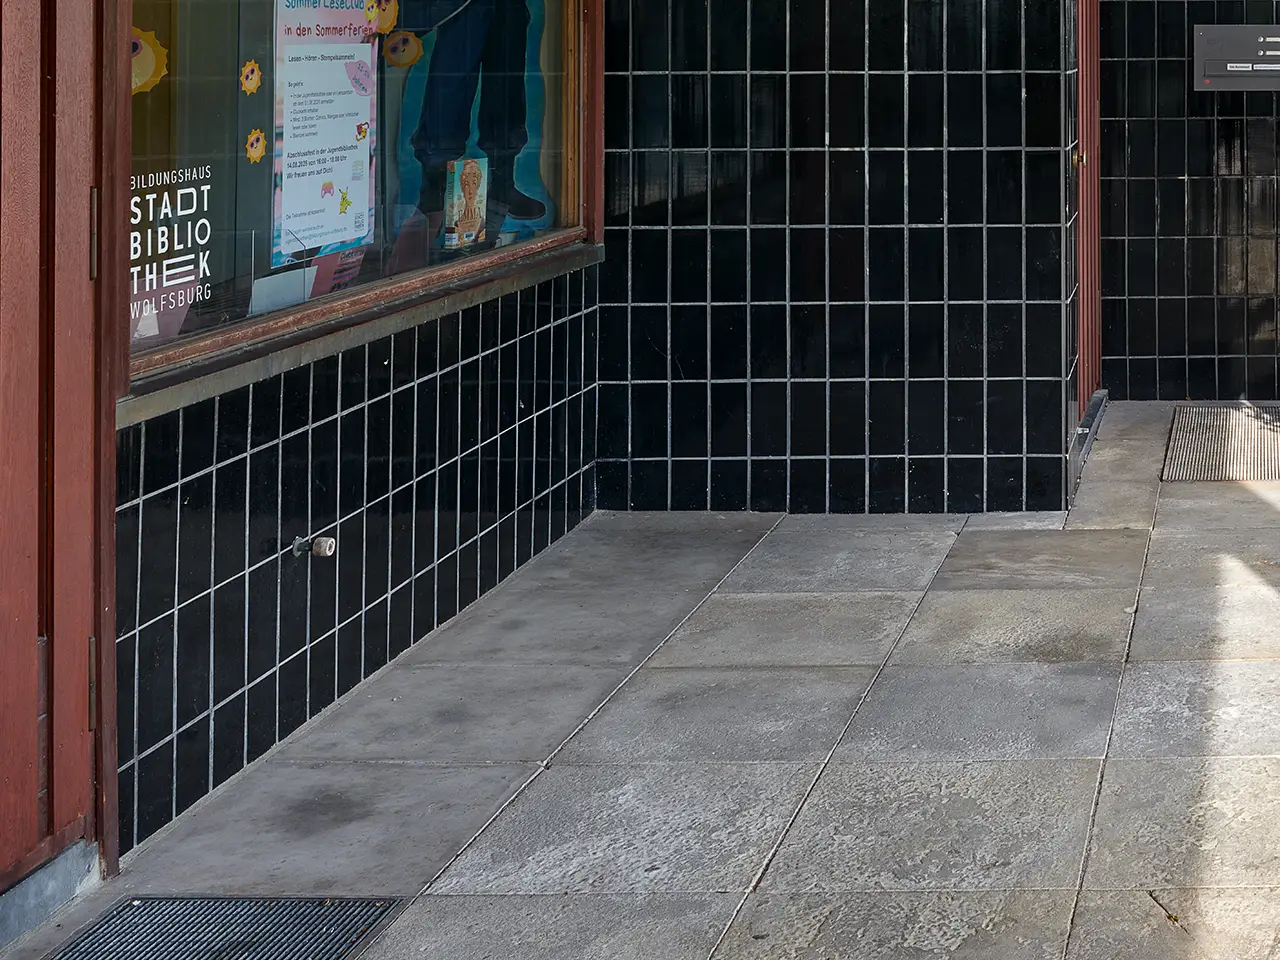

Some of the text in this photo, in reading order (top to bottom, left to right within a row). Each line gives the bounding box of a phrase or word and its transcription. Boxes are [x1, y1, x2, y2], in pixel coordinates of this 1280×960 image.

[284, 22, 374, 38] in den Sommerferien
[288, 55, 302, 63] Lesen
[130, 165, 212, 191] BILDUNGSHAUS
[130, 184, 211, 226] STADT
[130, 218, 211, 261] BIBLIO
[130, 250, 211, 295] THEK
[130, 283, 212, 320] WOLFSBURG
